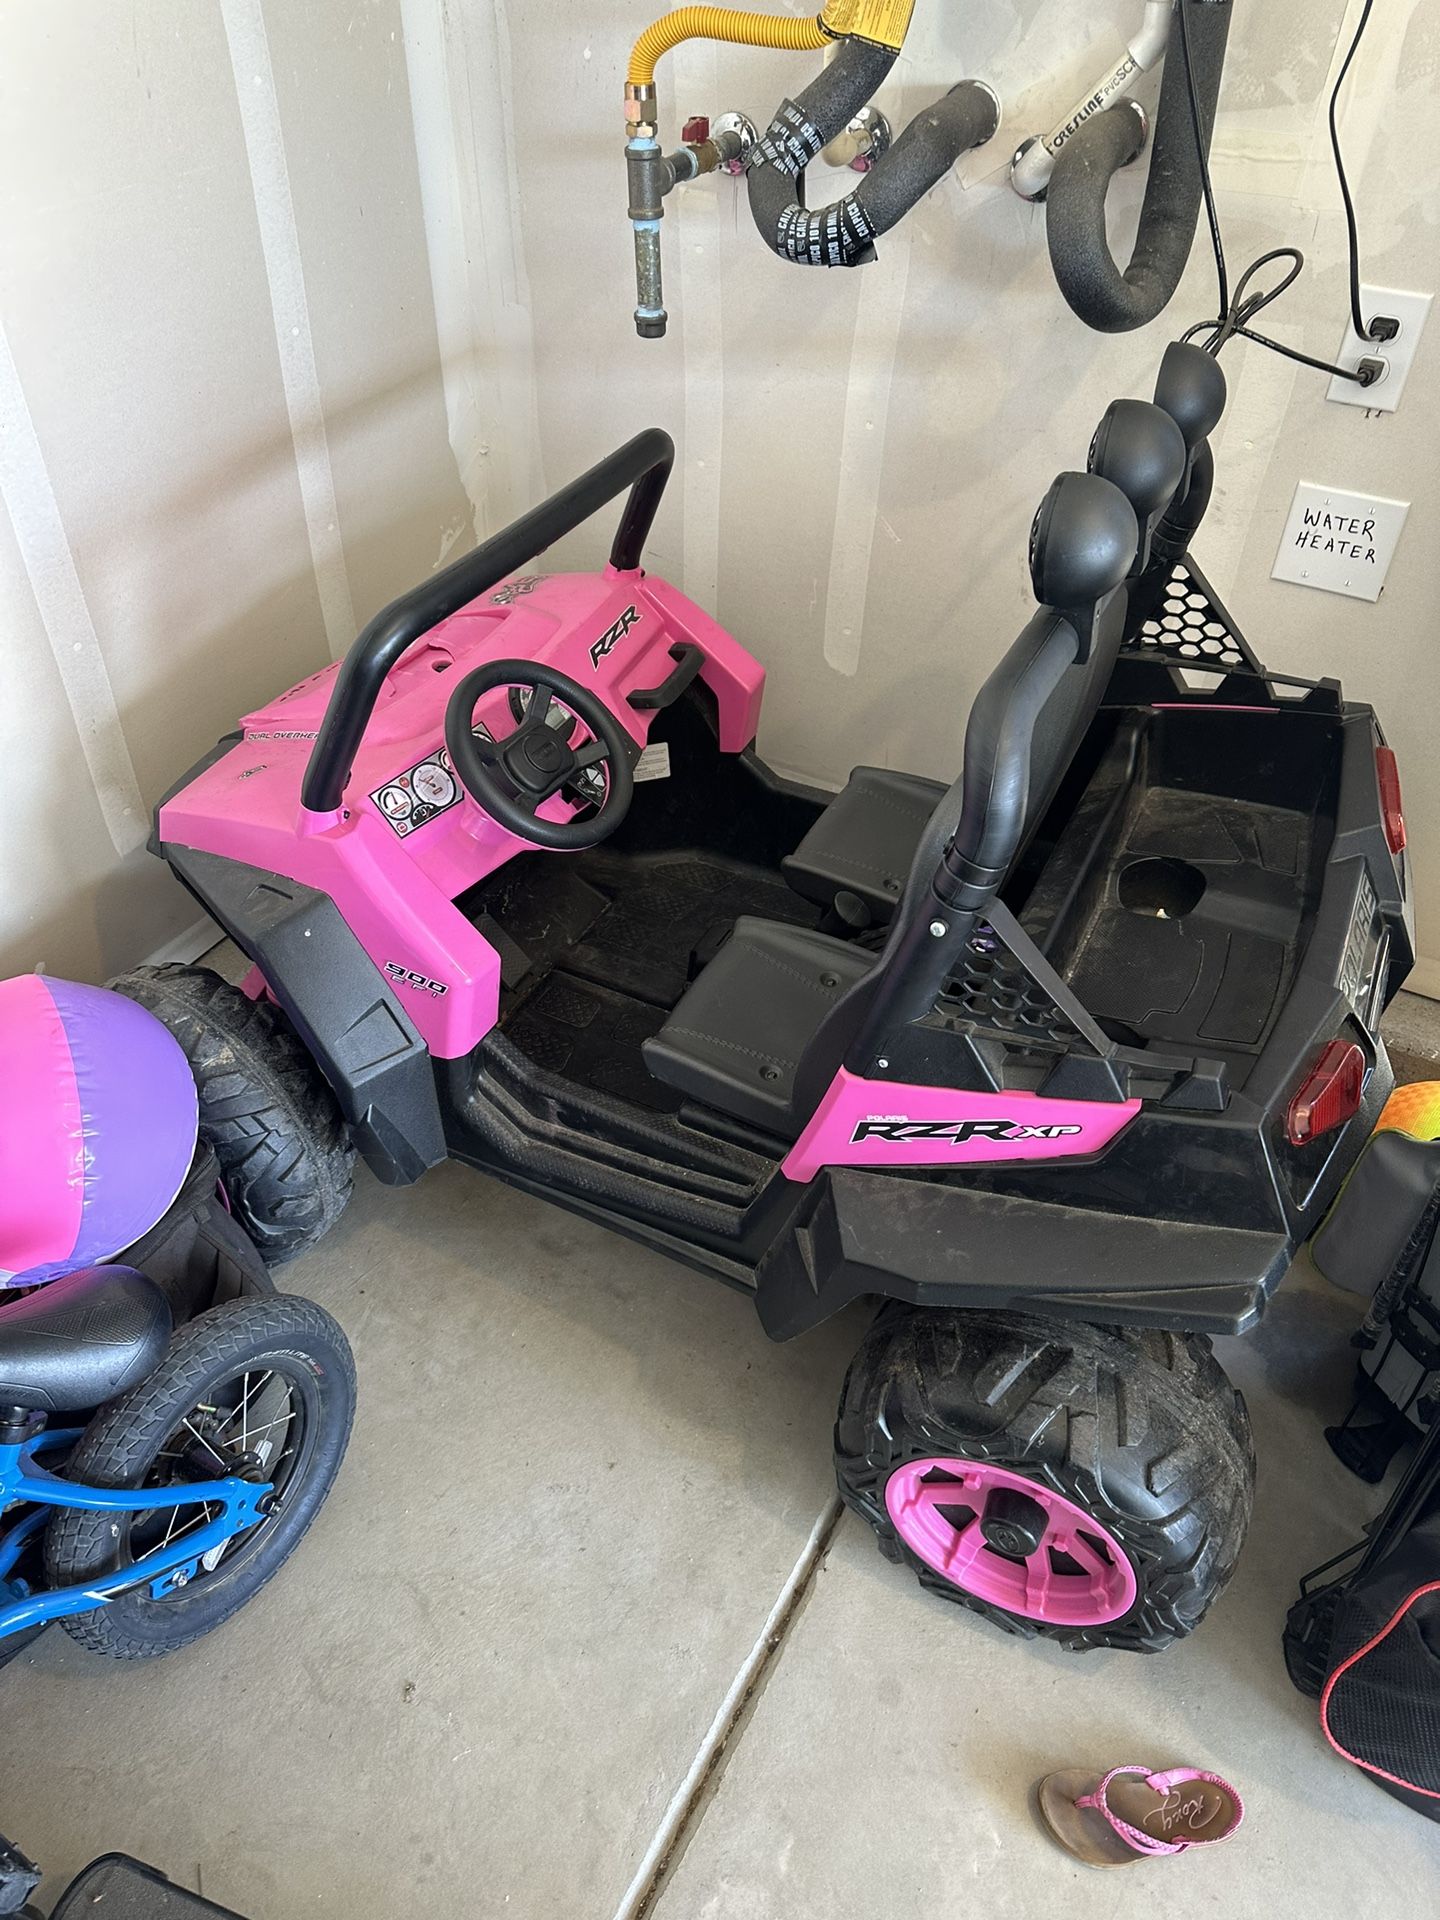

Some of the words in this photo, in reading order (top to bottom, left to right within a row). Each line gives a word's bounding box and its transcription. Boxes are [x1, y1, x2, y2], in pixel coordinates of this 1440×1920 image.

[1103, 77, 1121, 96] PVC
[787, 136, 809, 167] CALPICO
[800, 122, 822, 153] CALPICO
[827, 226, 838, 239] 10
[847, 202, 869, 238] CALPICO
[1304, 508, 1375, 542] WATER
[1295, 531, 1375, 564] HEATER
[589, 604, 643, 672] RZR
[384, 961, 449, 996] 900
[849, 1119, 1024, 1145] RZR
[1015, 1125, 1083, 1139] XP
